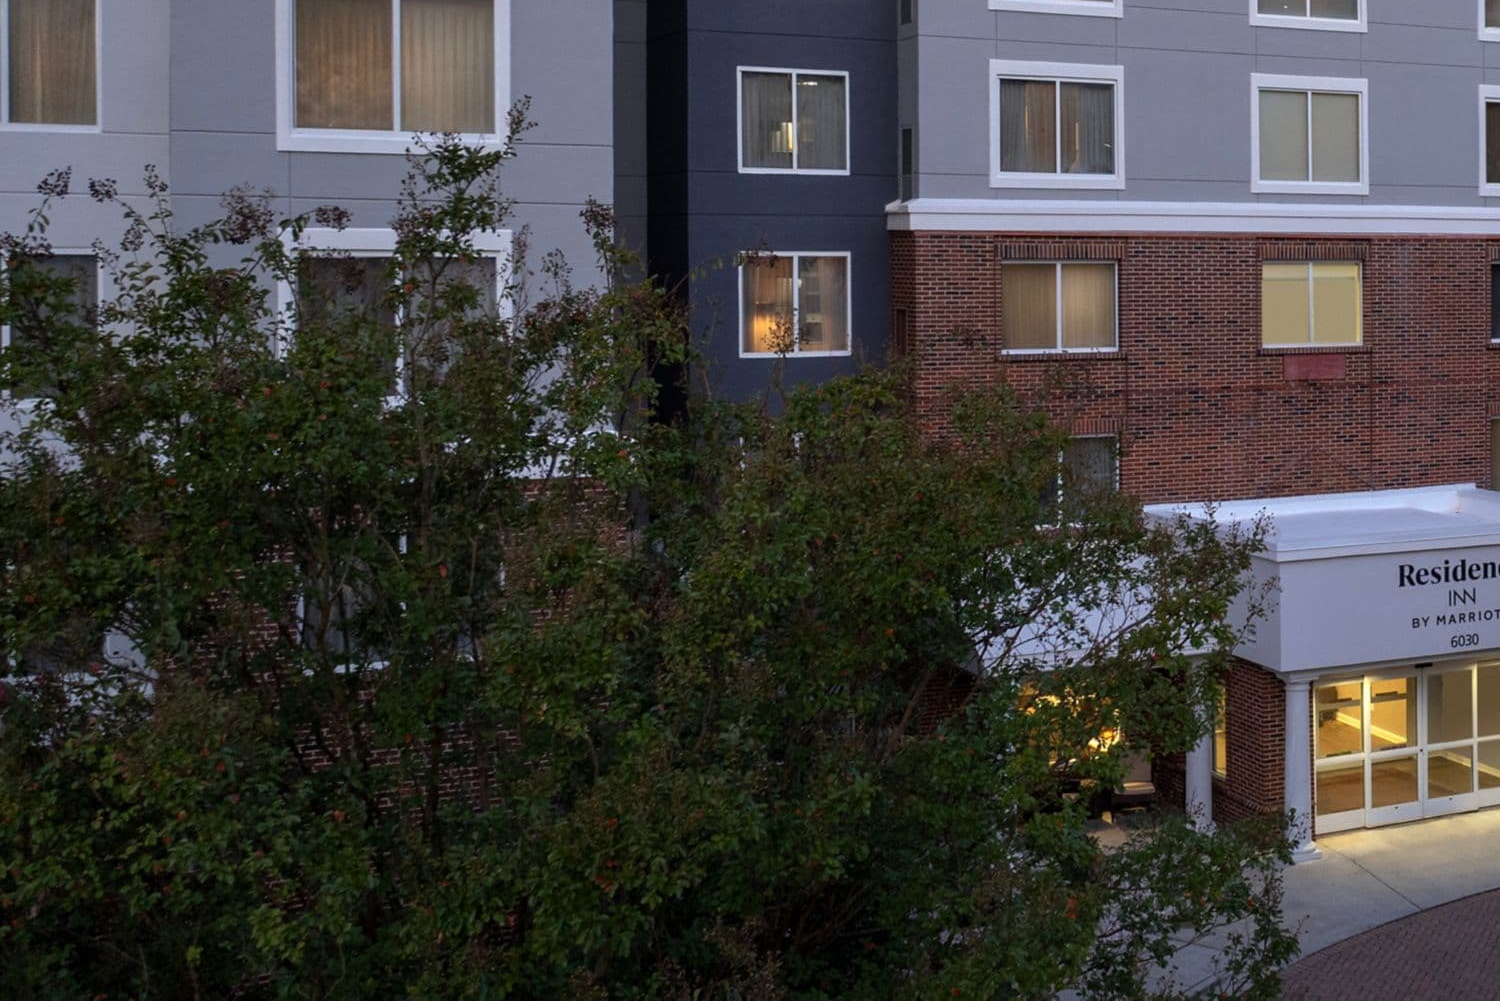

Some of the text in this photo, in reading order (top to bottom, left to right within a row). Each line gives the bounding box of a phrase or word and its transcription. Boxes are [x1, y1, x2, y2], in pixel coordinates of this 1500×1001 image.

[1448, 588, 1476, 606] INN
[1412, 616, 1430, 628] BY
[1451, 633, 1480, 648] 6030
